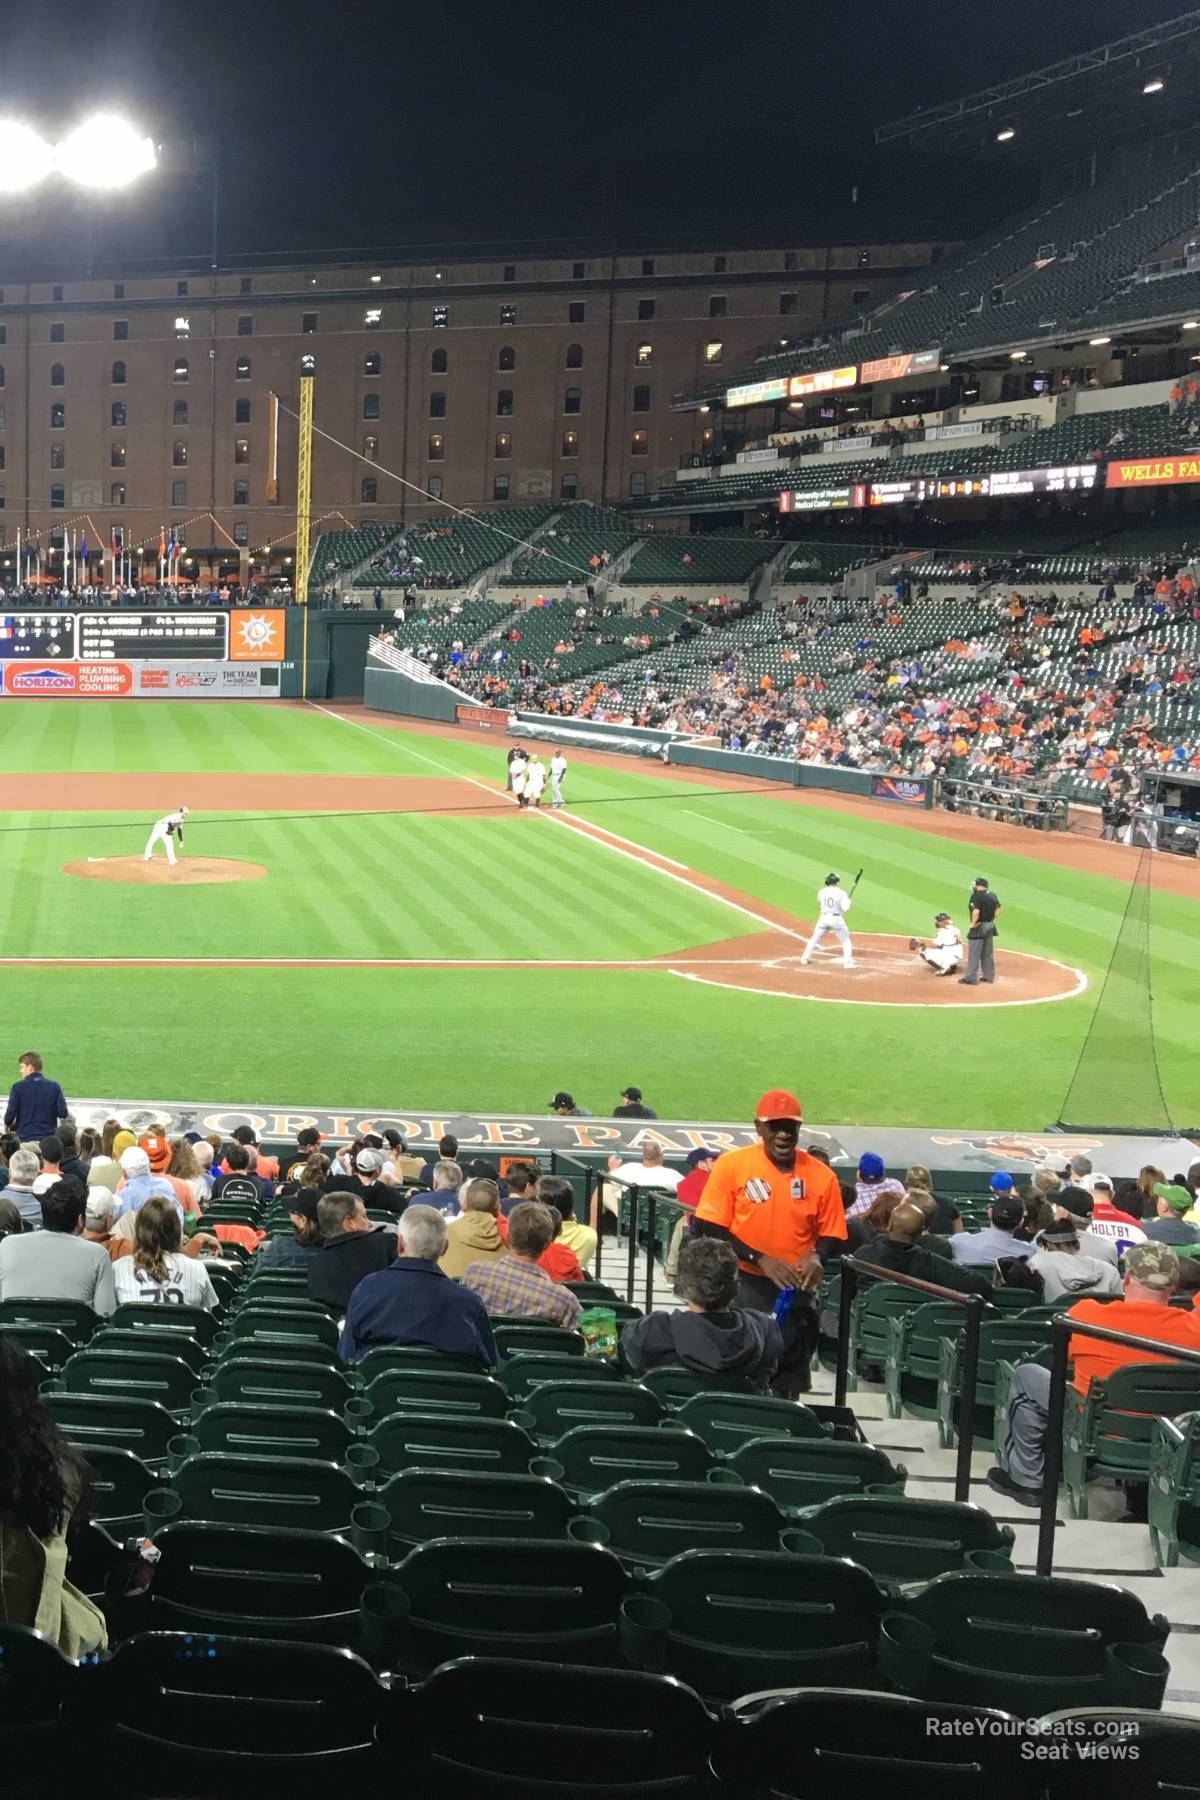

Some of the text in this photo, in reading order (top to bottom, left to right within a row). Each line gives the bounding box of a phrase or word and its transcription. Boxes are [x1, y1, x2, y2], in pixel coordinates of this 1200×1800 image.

[1120, 463, 1174, 481] WELLS
[795, 491, 819, 501] University
[825, 488, 849, 499] Maryland
[813, 500, 831, 508] Center
[79, 666, 119, 675] HEATING
[223, 671, 237, 679] THE
[238, 671, 257, 679] TEAM
[14, 677, 75, 688] HORIZON
[79, 675, 125, 683] PLUMBING
[79, 684, 119, 692] COOLING
[202, 1111, 541, 1147] ORIOLE
[1091, 1223, 1130, 1238] HOLTBY
